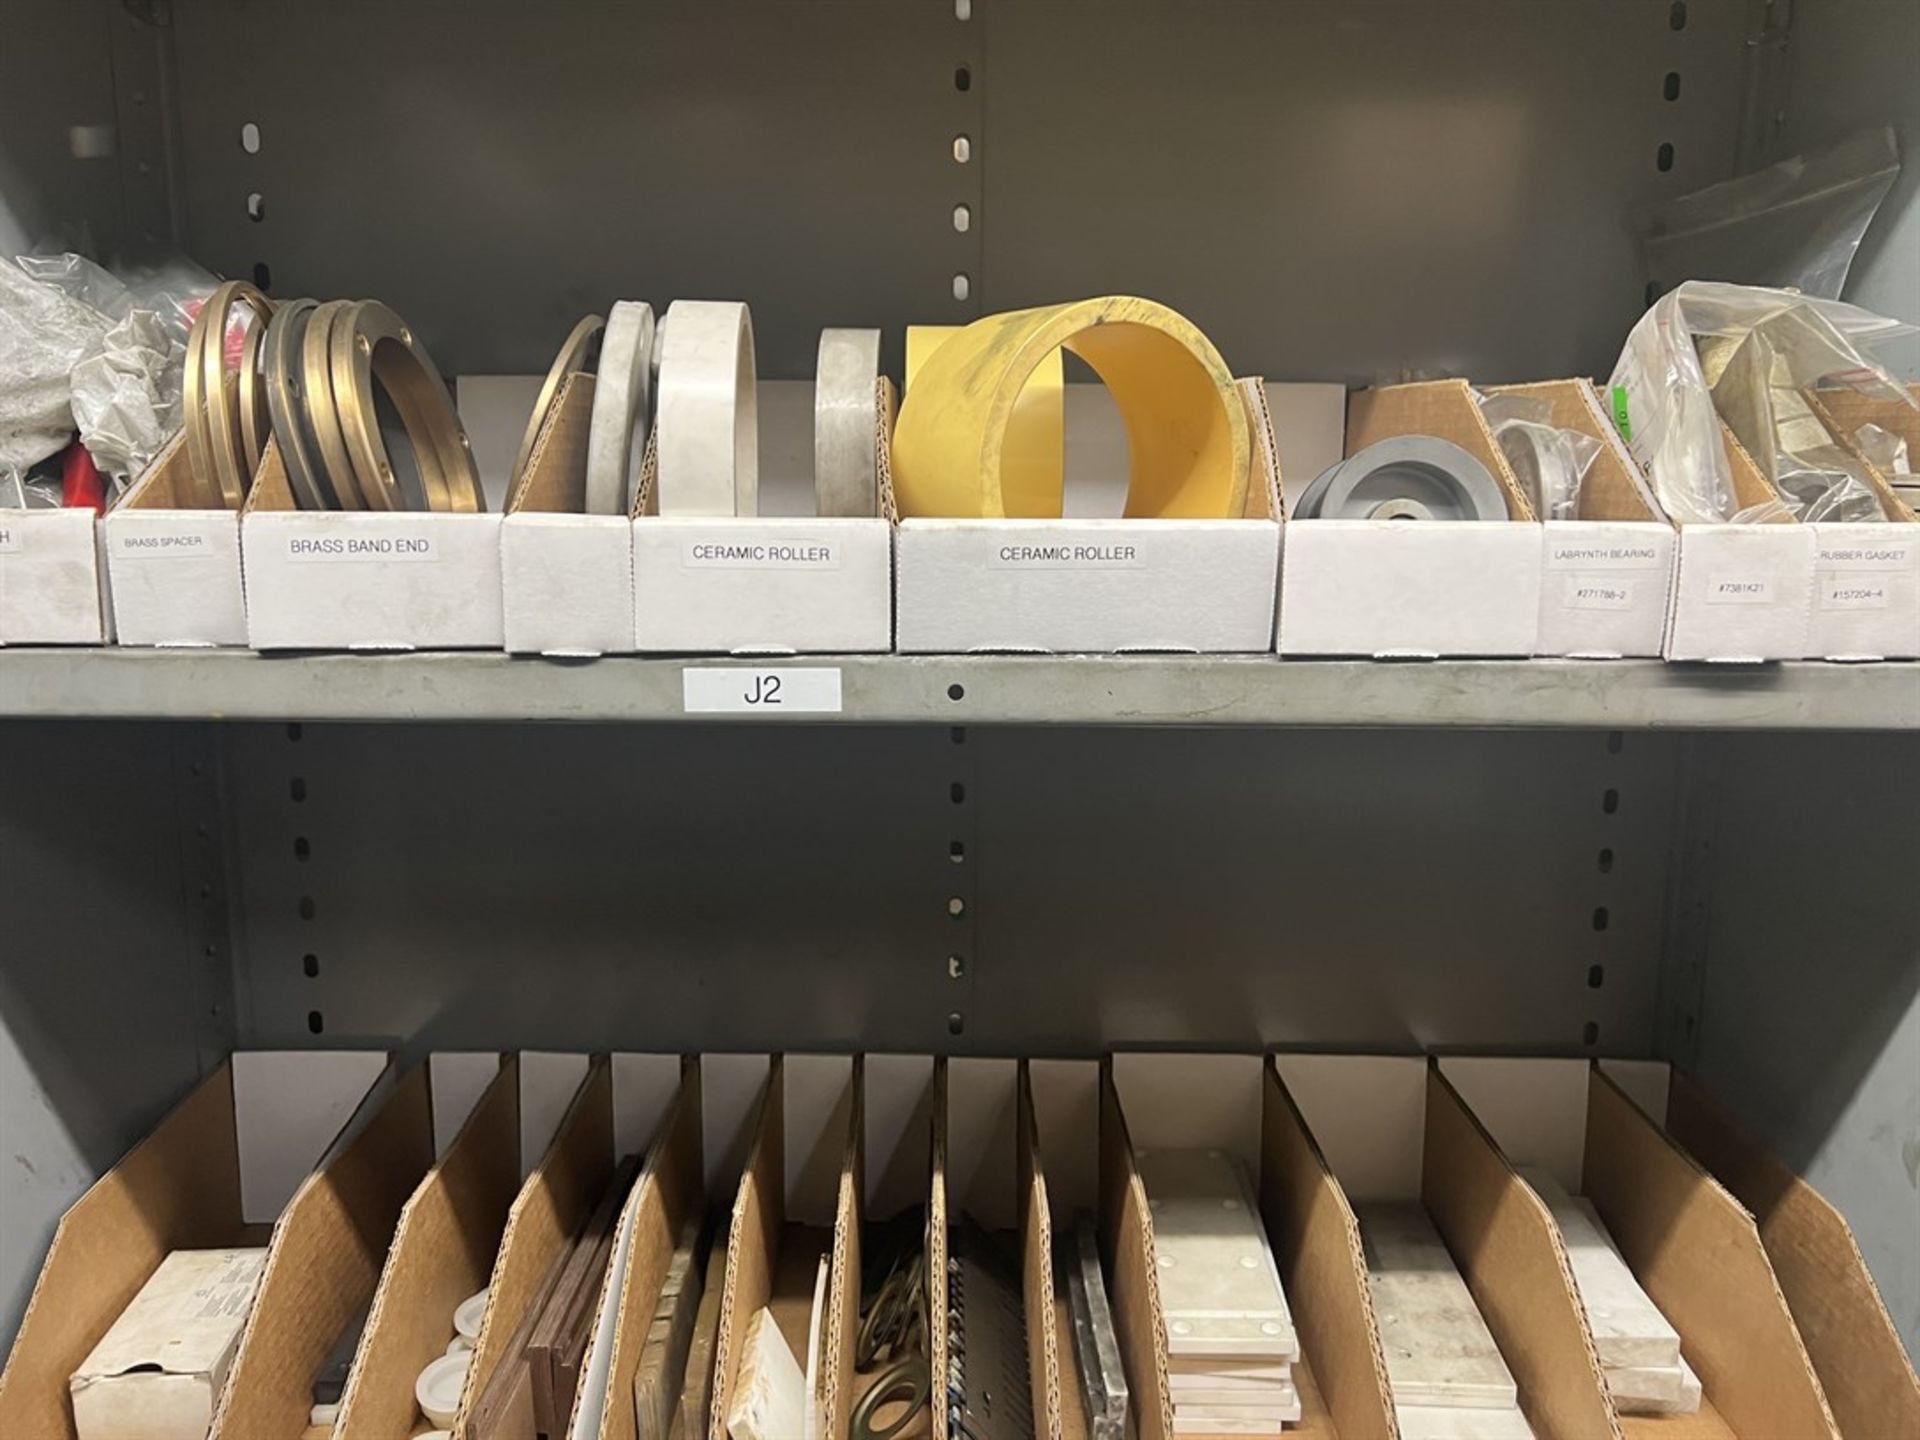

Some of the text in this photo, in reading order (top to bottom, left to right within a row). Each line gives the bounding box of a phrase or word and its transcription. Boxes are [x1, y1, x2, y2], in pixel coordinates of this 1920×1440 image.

[124, 536, 203, 548] BRASS SPACER
[290, 538, 430, 554] BRASS BAND END
[692, 545, 831, 562] CERAMIC ROLLER
[999, 545, 1136, 562] CERAMIC ROLLER
[1554, 549, 1656, 560] LABRYNTH BEARING
[1819, 550, 1906, 561] RUBBER GASKET
[743, 675, 783, 704] J2
